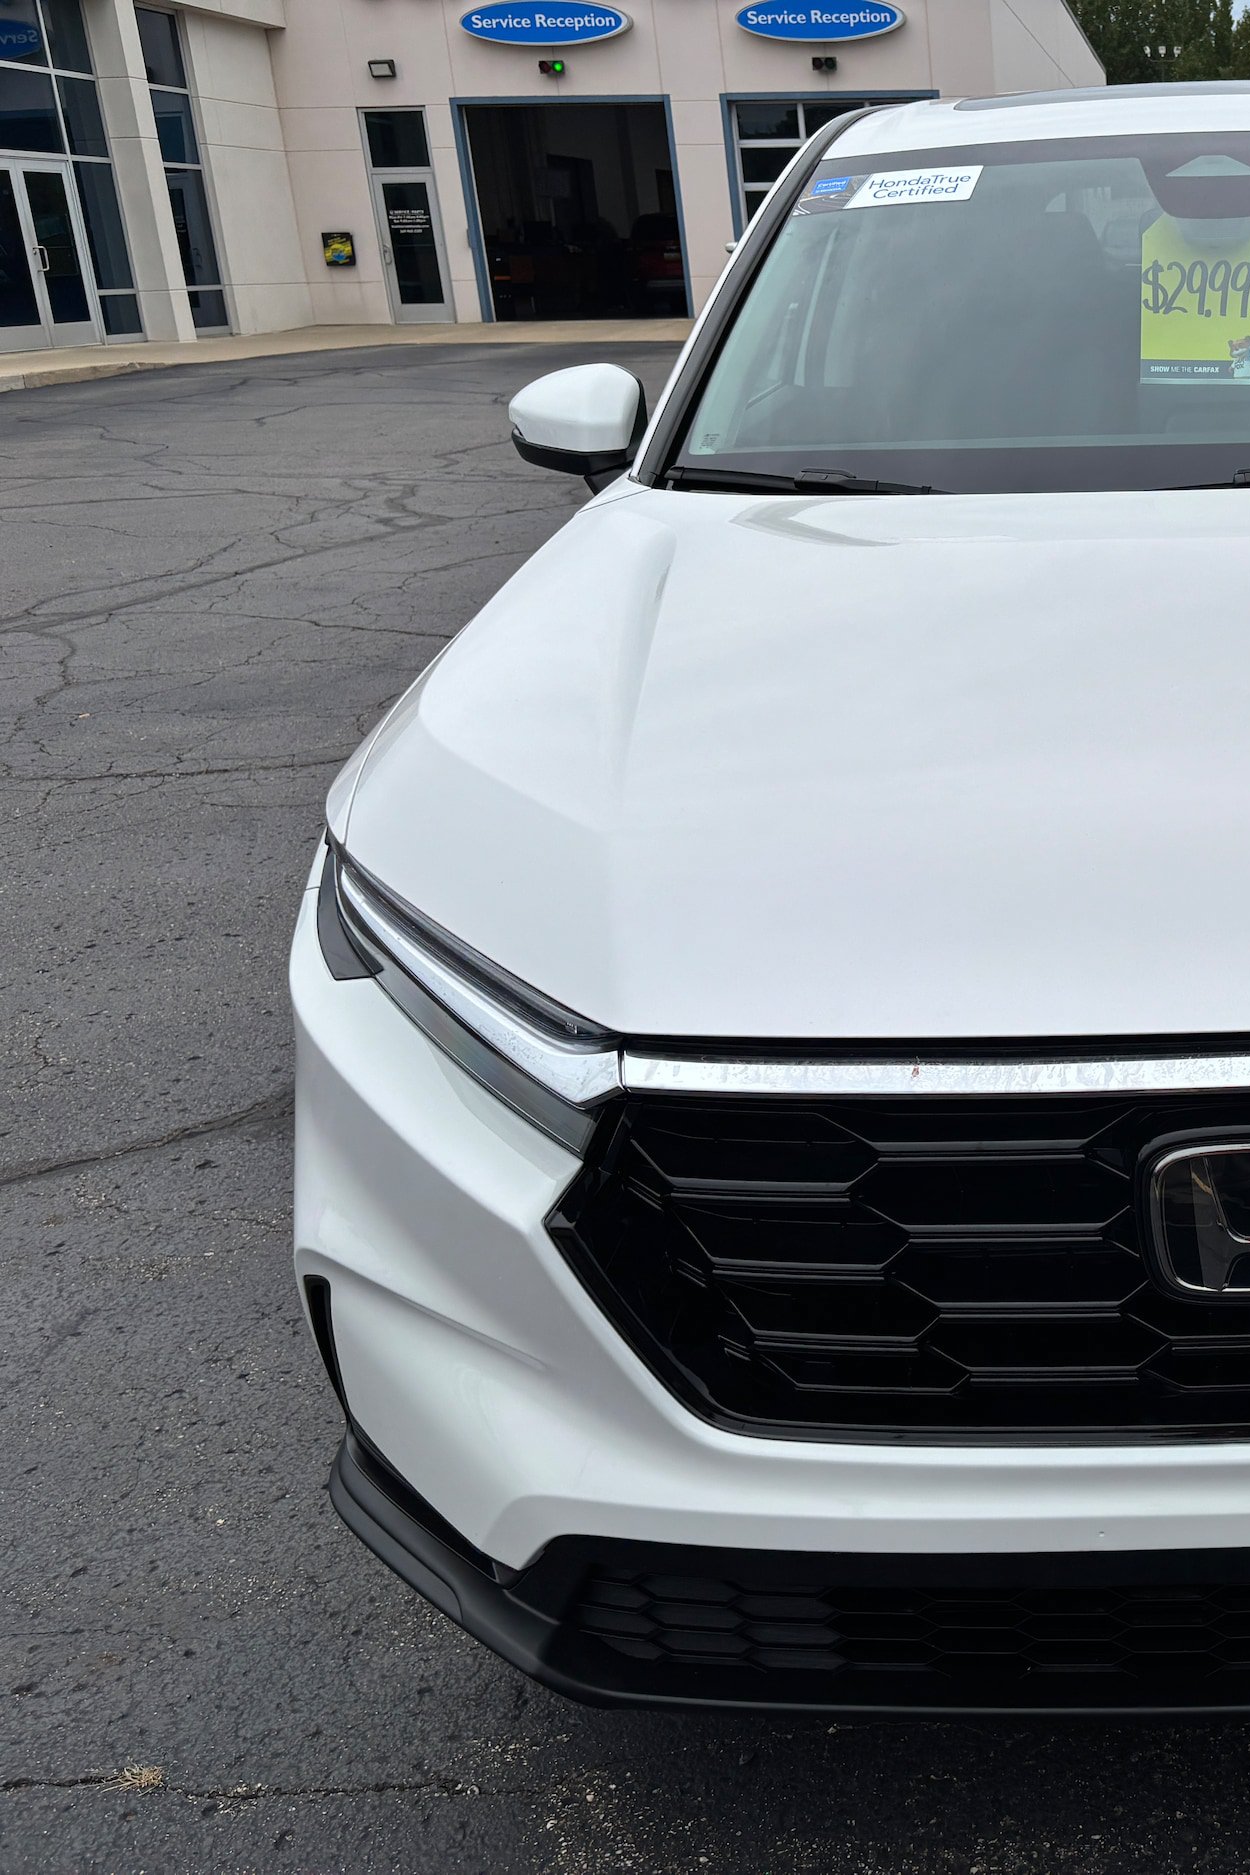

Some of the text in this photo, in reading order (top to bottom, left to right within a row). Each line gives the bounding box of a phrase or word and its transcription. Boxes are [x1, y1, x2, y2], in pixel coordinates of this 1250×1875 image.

[471, 13, 616, 31] Service Reception
[746, 9, 891, 27] Service Reception
[868, 174, 972, 190] HondaTrue
[873, 183, 959, 199] Certified
[1150, 365, 1170, 373] SHOW
